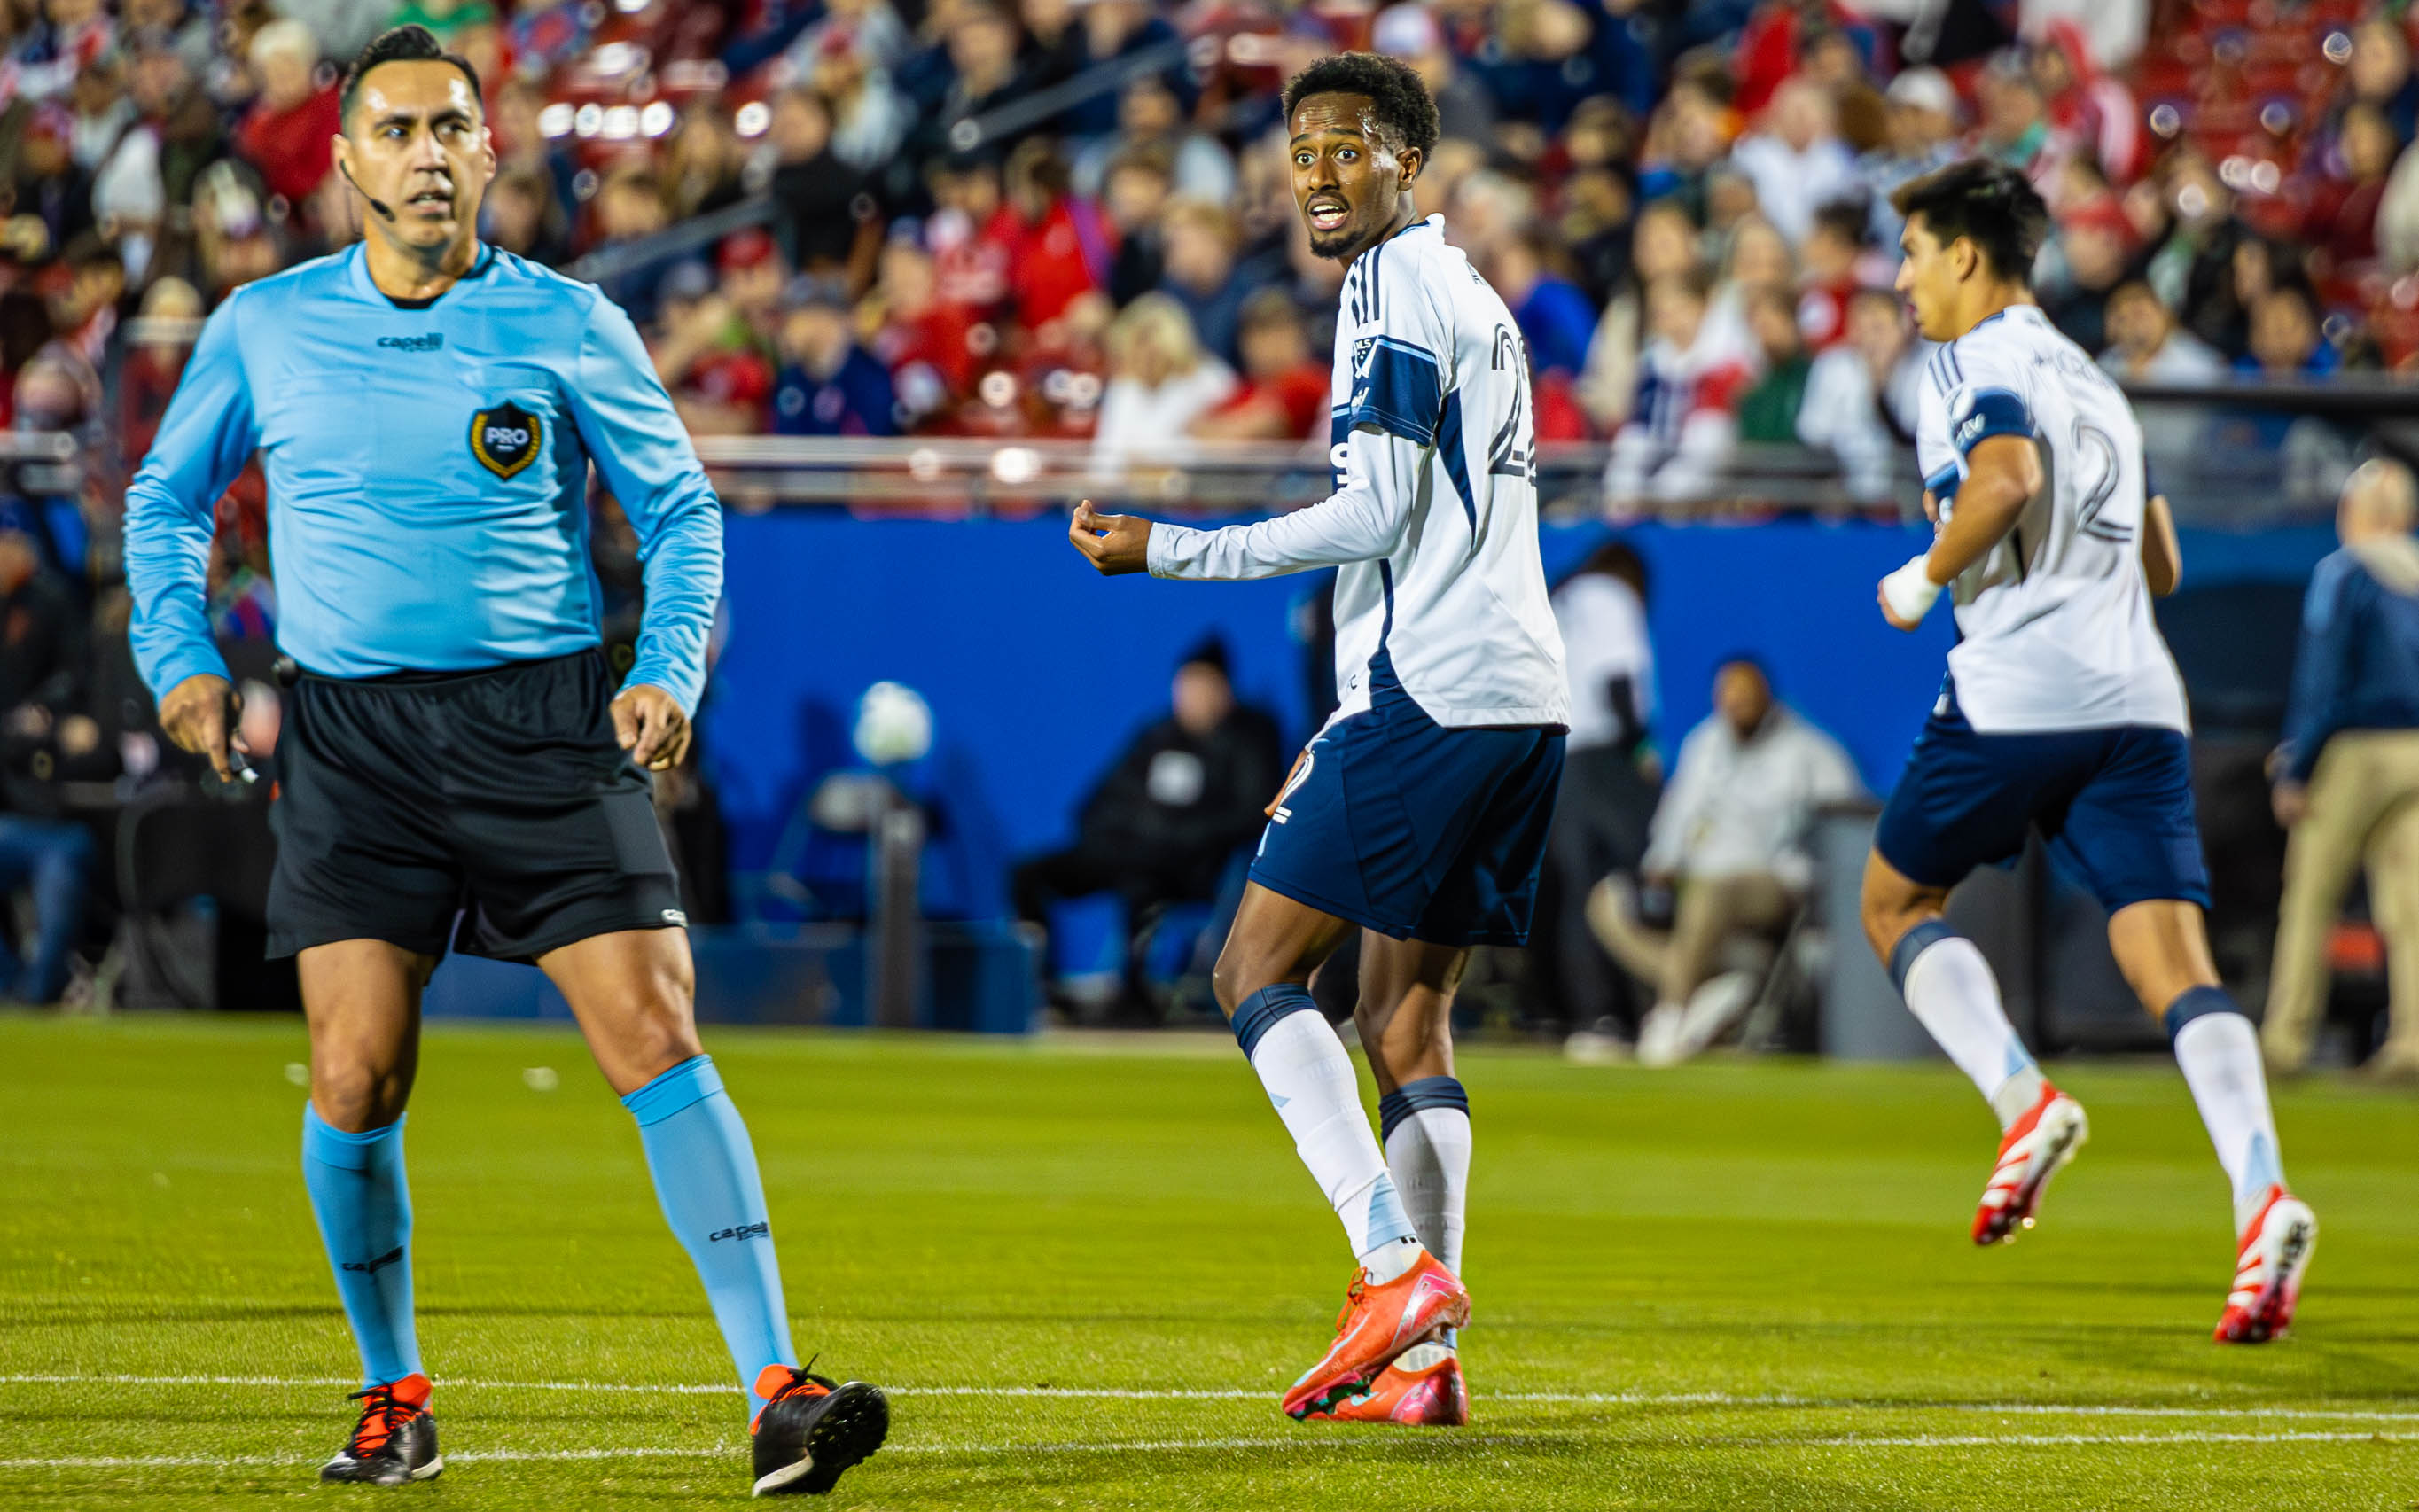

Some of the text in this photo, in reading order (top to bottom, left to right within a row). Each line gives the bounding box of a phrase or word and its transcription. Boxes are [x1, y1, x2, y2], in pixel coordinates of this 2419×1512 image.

[1356, 339, 1372, 349] MLS
[485, 426, 529, 446] PRO
[2069, 414, 2134, 543] 2
